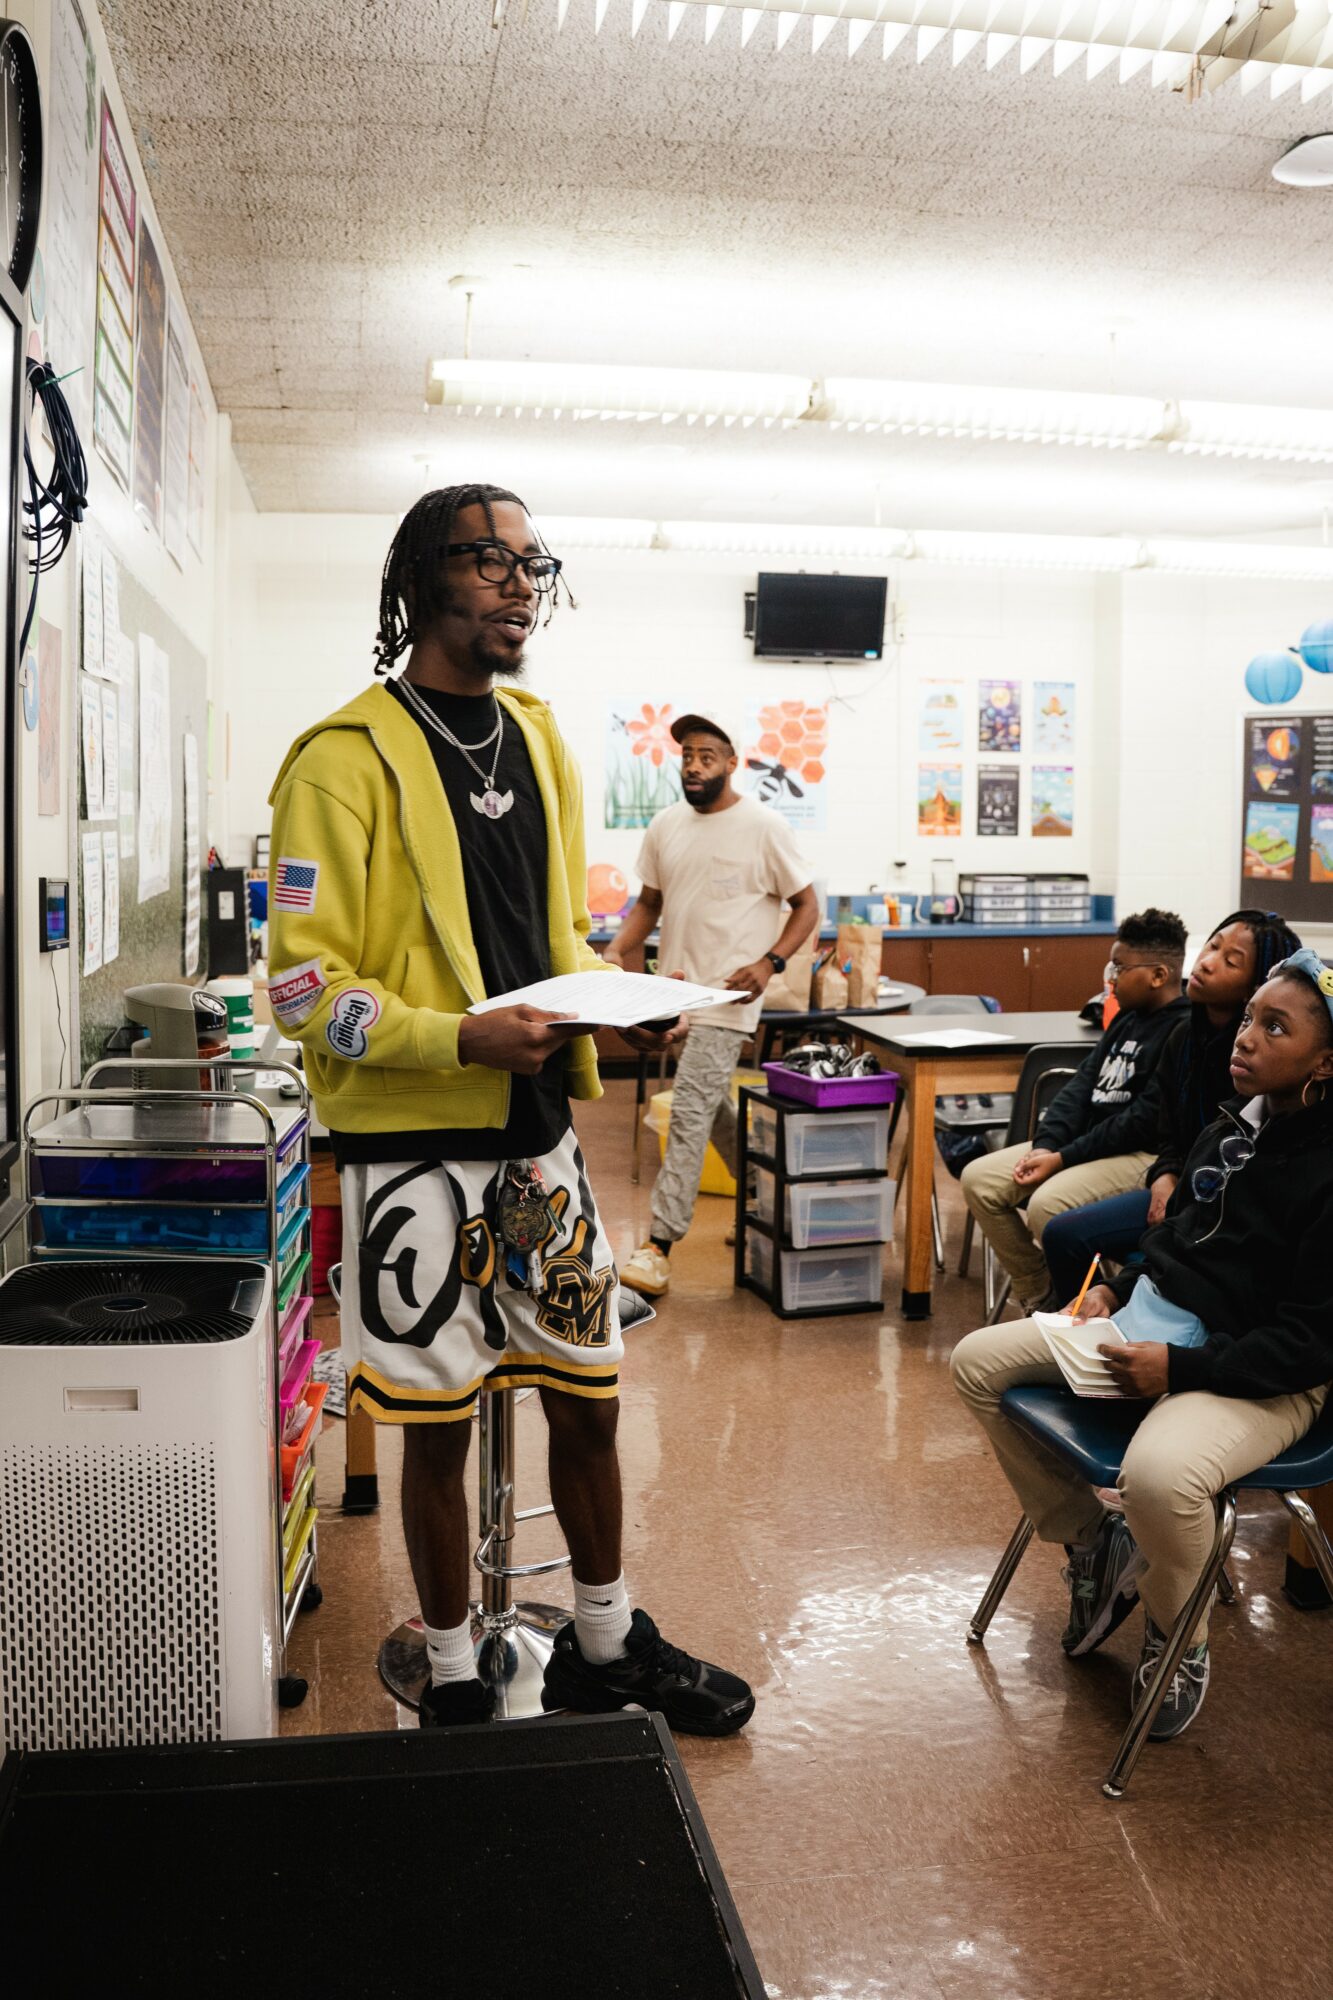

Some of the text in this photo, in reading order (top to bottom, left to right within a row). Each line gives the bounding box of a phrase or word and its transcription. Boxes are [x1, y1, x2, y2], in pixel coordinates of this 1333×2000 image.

[19, 150, 24, 170] 2
[16, 201, 21, 221] 3
[270, 976, 314, 1002] OFFICIAL
[337, 999, 368, 1049] official
[1078, 1579, 1095, 1599] N
